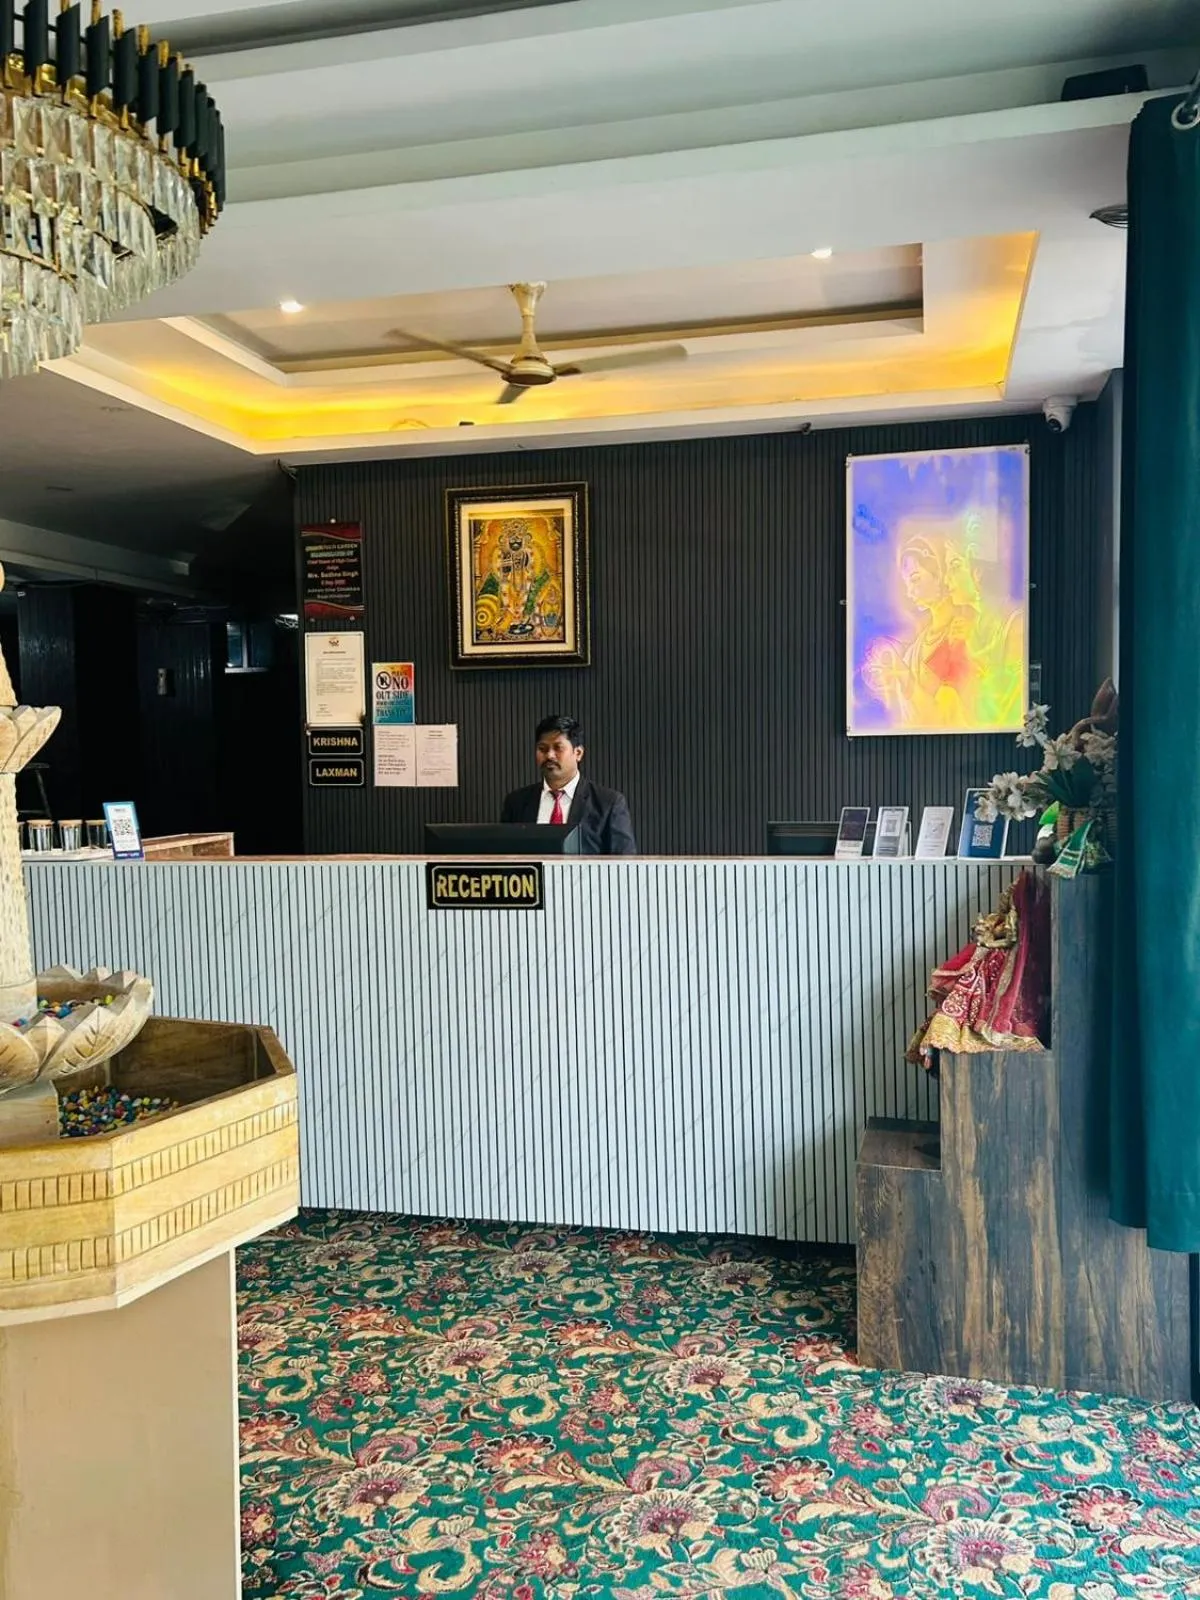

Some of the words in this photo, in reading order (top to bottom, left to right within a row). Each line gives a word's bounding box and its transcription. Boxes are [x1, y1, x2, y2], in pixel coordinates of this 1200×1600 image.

[392, 676, 409, 690] NO
[376, 691, 391, 700] OUT
[313, 736, 358, 747] KRISHNA
[316, 767, 358, 777] LAXMAN
[436, 874, 535, 898] RECEPTION
